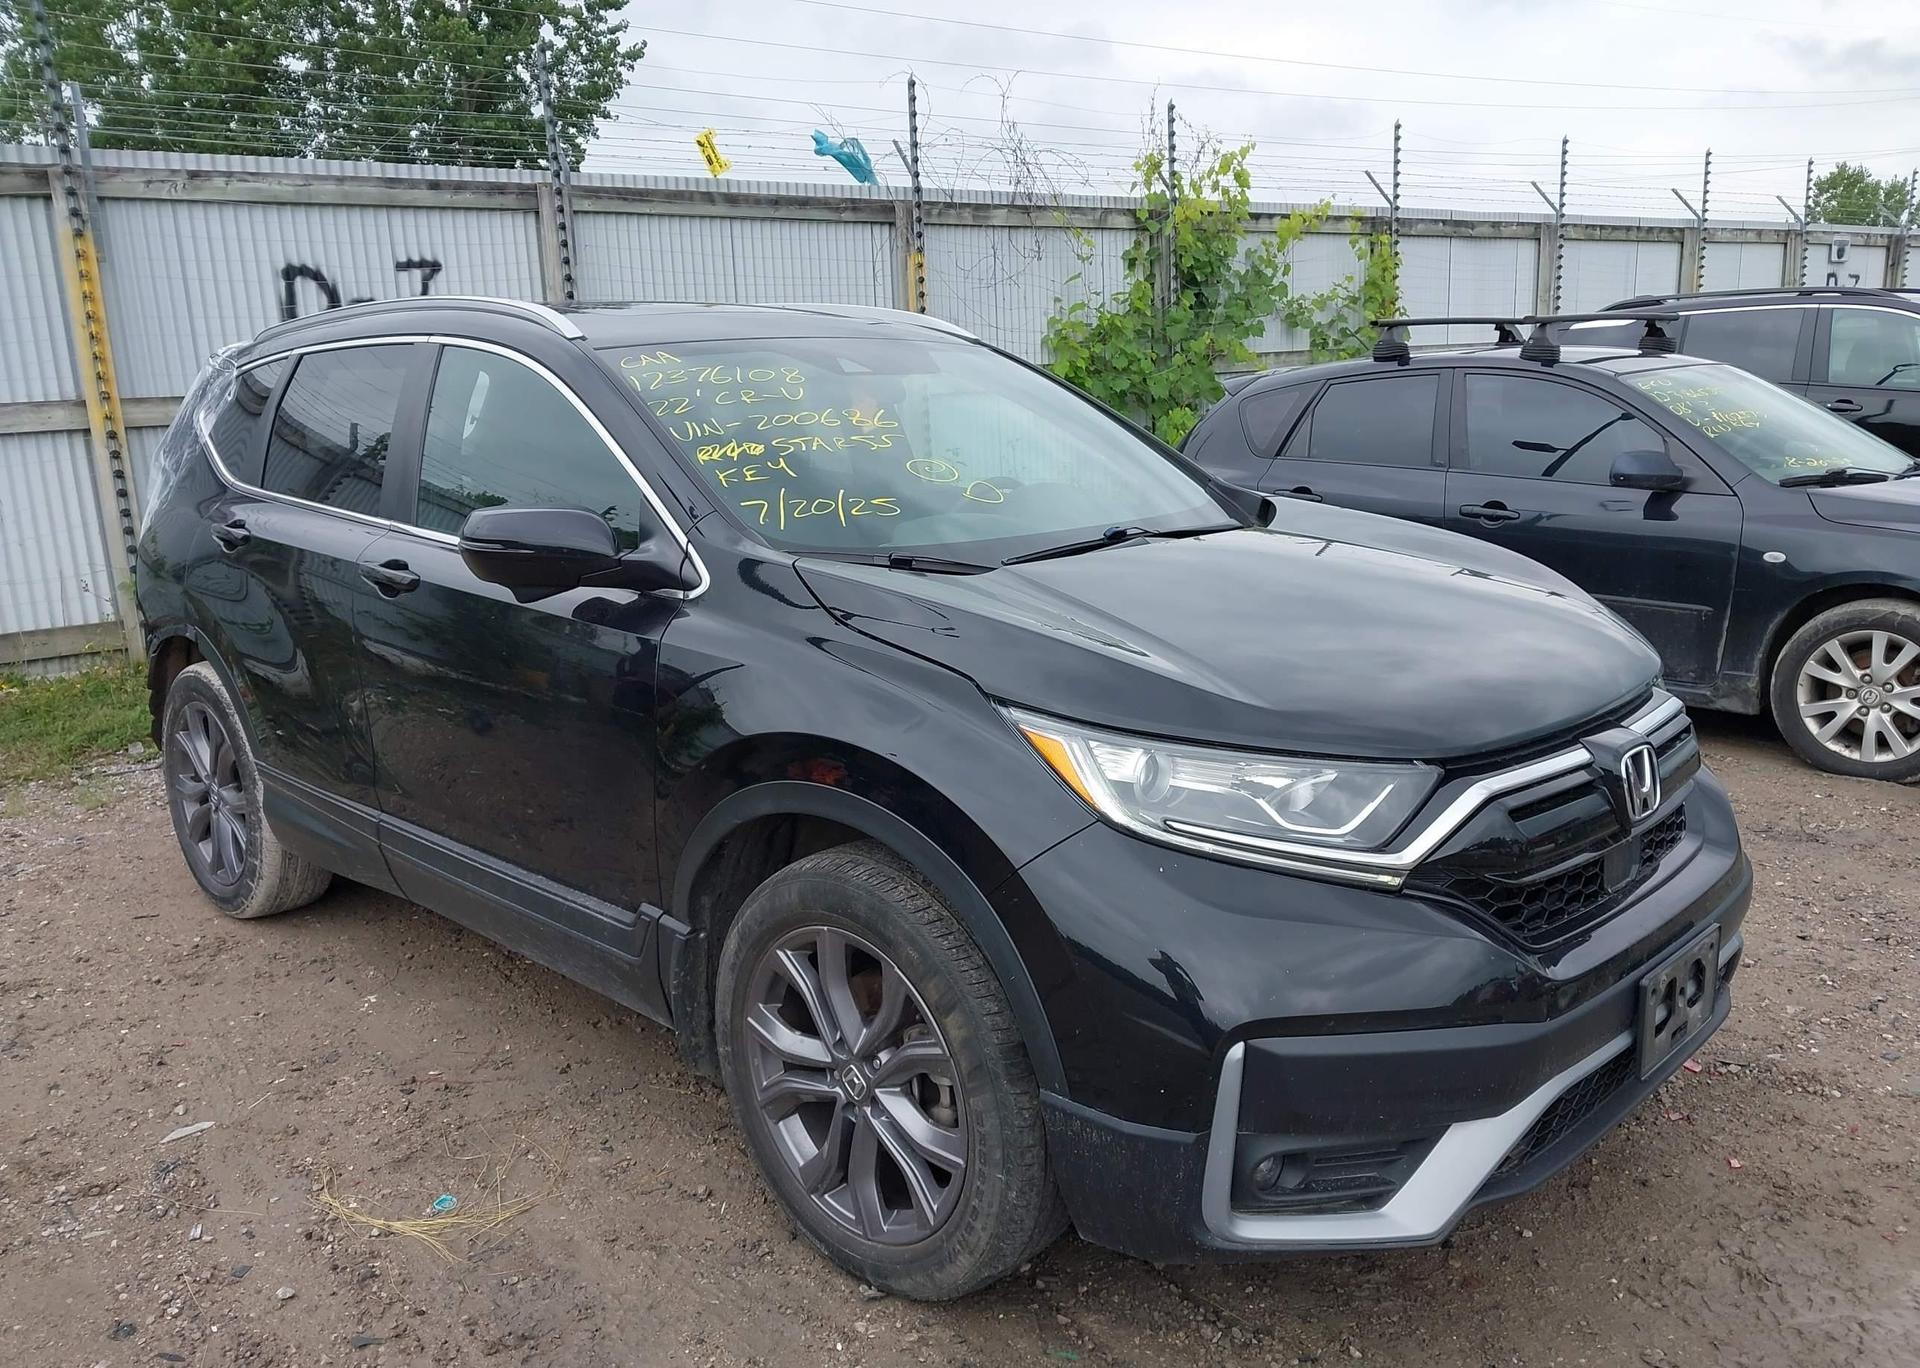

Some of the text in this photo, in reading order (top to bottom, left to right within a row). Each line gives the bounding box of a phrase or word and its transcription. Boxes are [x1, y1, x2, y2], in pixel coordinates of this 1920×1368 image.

[620, 351, 682, 369] CAA
[629, 365, 805, 391] 12376108
[748, 408, 898, 430] 200686
[715, 457, 797, 487] KEY
[740, 487, 901, 530] 7/20/25
